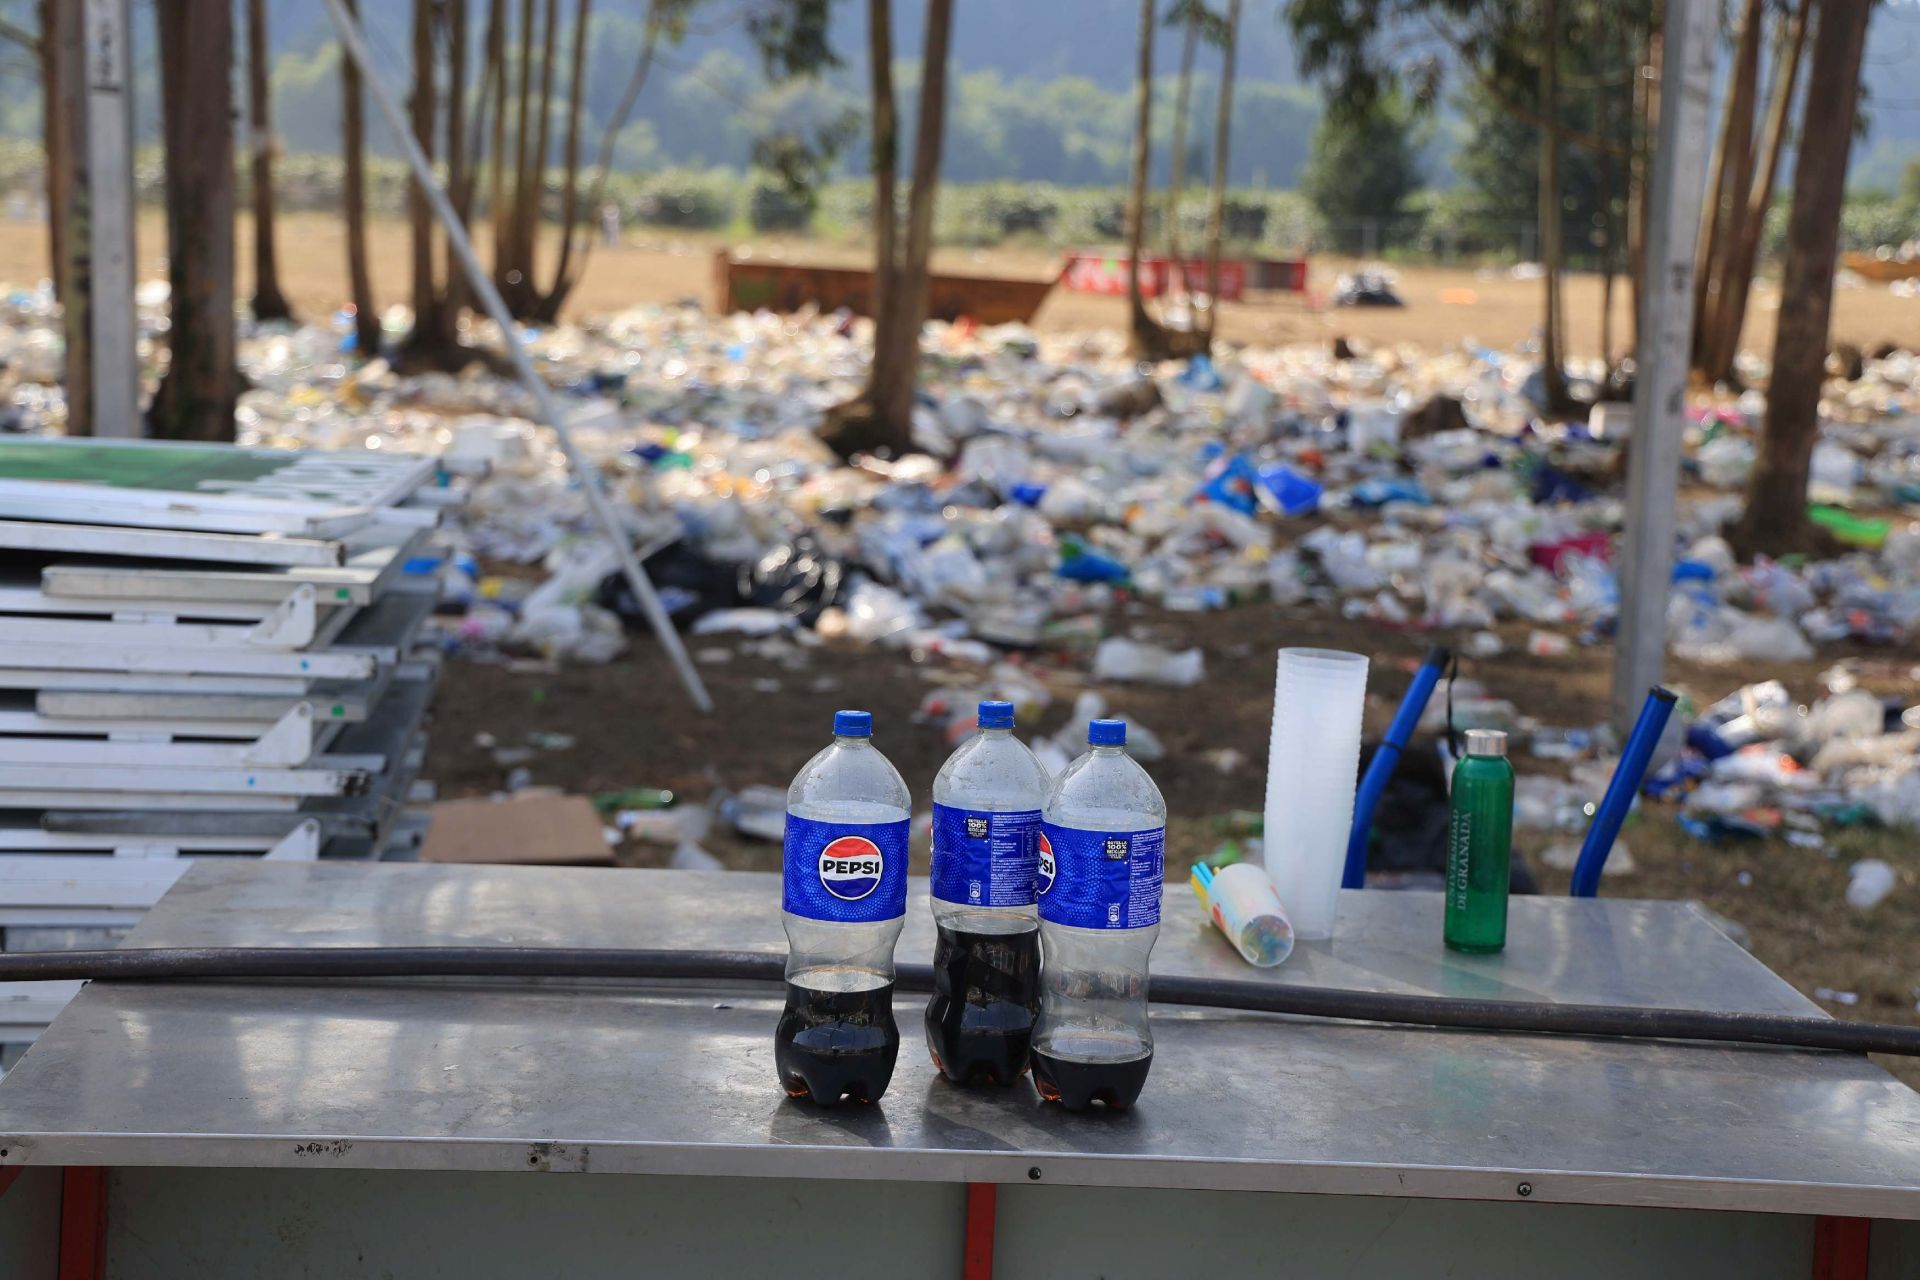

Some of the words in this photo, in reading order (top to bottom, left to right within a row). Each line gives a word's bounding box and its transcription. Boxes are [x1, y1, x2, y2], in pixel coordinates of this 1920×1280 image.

[1448, 808, 1459, 907] UNIVERSIDAD
[1457, 811, 1471, 891] GRANADA
[823, 860, 879, 874] PEPSI
[1038, 856, 1053, 874] PSI
[1457, 891, 1466, 911] DE
